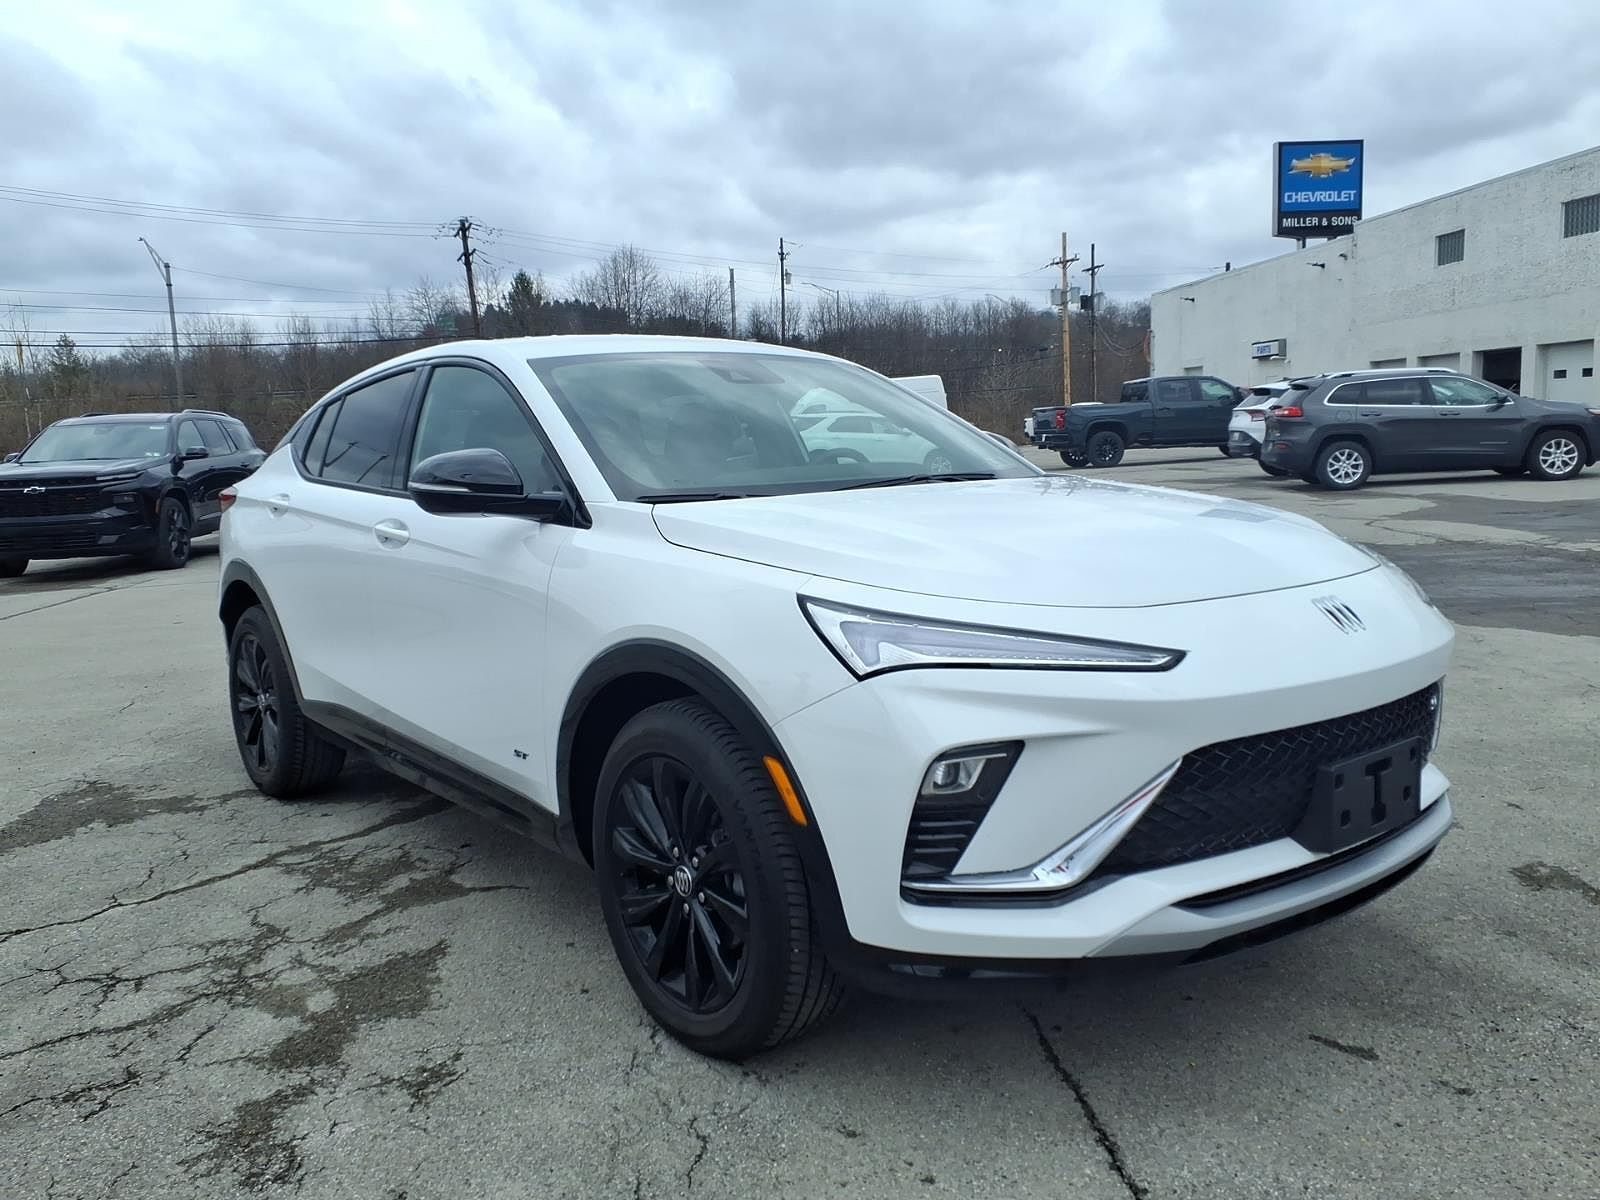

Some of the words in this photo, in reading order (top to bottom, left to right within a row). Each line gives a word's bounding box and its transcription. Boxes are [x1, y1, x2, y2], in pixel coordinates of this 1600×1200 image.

[1284, 190, 1357, 203] CHEVROLET
[1282, 217, 1319, 227] MILLER
[1321, 217, 1328, 226] &
[1331, 216, 1358, 226] SONS
[513, 749, 529, 760] ST
